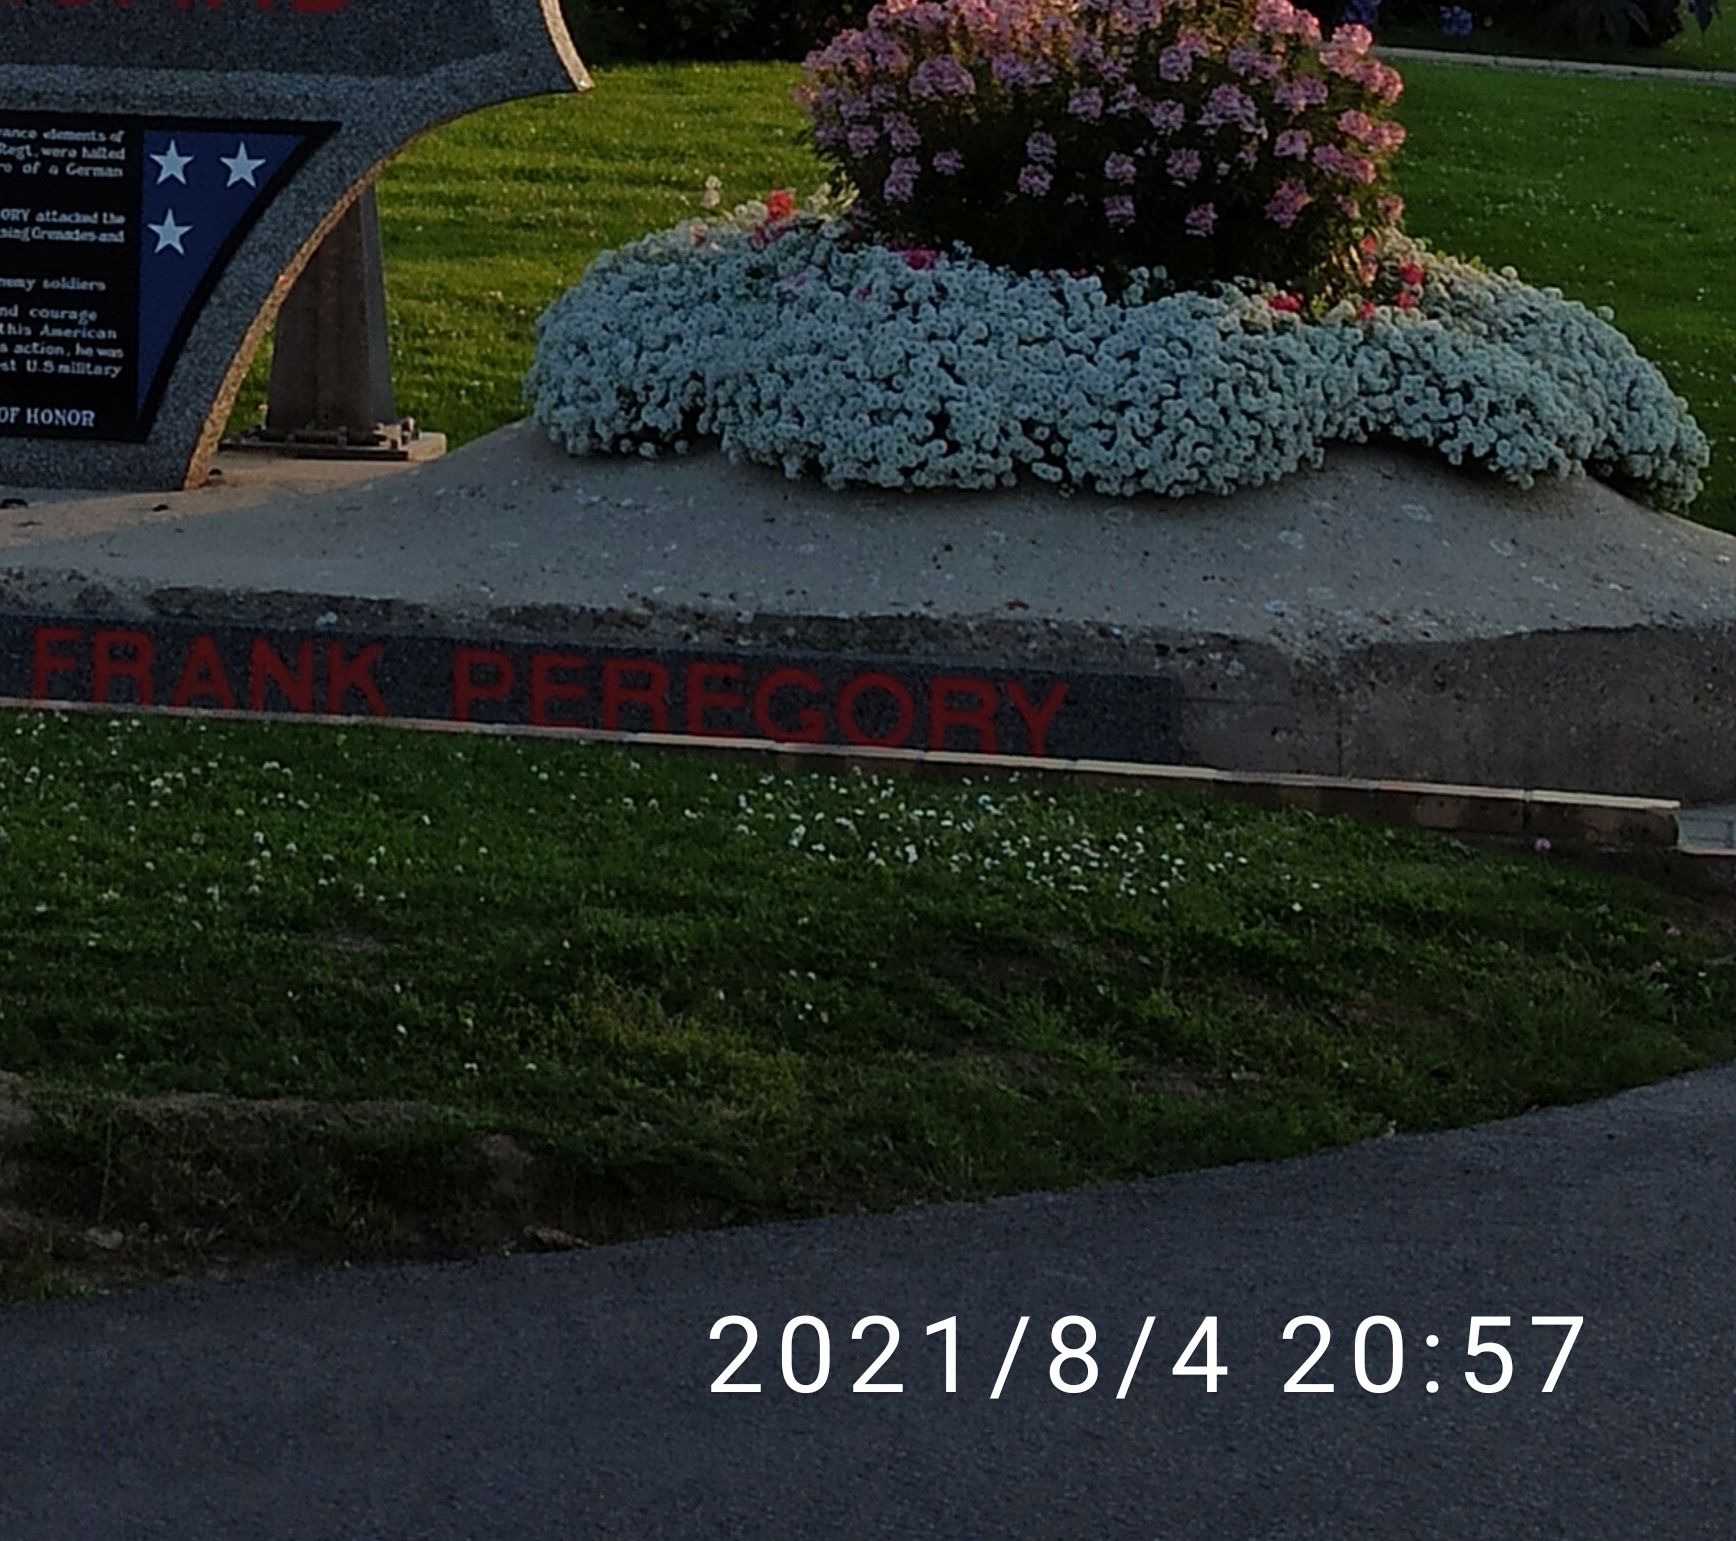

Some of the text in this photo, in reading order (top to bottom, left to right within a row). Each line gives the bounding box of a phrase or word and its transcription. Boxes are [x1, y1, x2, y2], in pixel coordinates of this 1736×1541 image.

[42, 128, 106, 142] elements
[109, 130, 125, 143] of
[40, 147, 78, 159] were
[81, 147, 126, 160] halted
[22, 161, 41, 174] of
[48, 164, 59, 175] a
[65, 162, 123, 178] German
[35, 209, 99, 224] attacked
[102, 211, 126, 225] the
[97, 229, 125, 243] and
[42, 276, 106, 291] soldiers
[28, 308, 97, 325] courage
[39, 322, 117, 339] American
[75, 342, 94, 357] he
[96, 348, 124, 358] was
[57, 361, 122, 378] military
[26, 407, 96, 427] HONOR
[34, 627, 387, 717] FRANK
[453, 649, 1068, 757] PEREGORY
